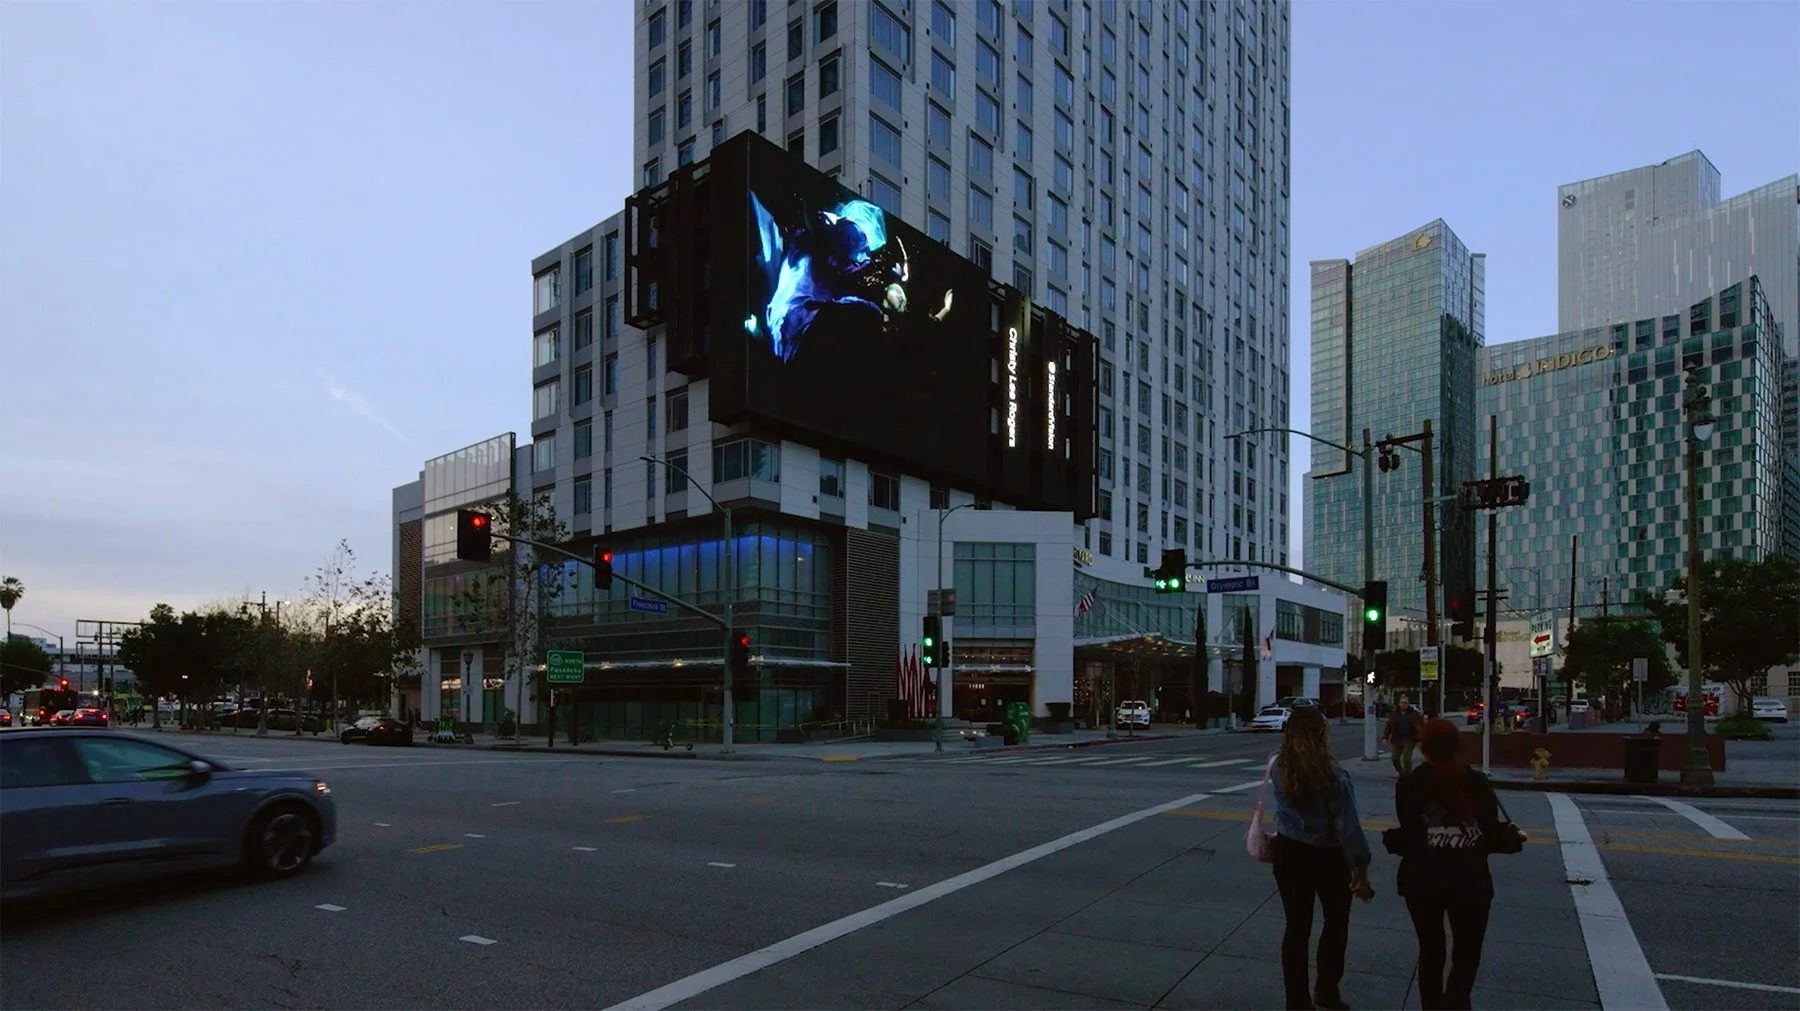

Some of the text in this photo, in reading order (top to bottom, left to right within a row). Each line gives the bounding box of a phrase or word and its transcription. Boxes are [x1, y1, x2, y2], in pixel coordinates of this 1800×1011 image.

[1482, 344, 1612, 387] hotel INDIGO
[1007, 327, 1018, 448] Christy Lee Rogers
[1210, 580, 1244, 591] Olympic
[632, 599, 659, 610] Francisco
[1531, 619, 1552, 633] PARKING
